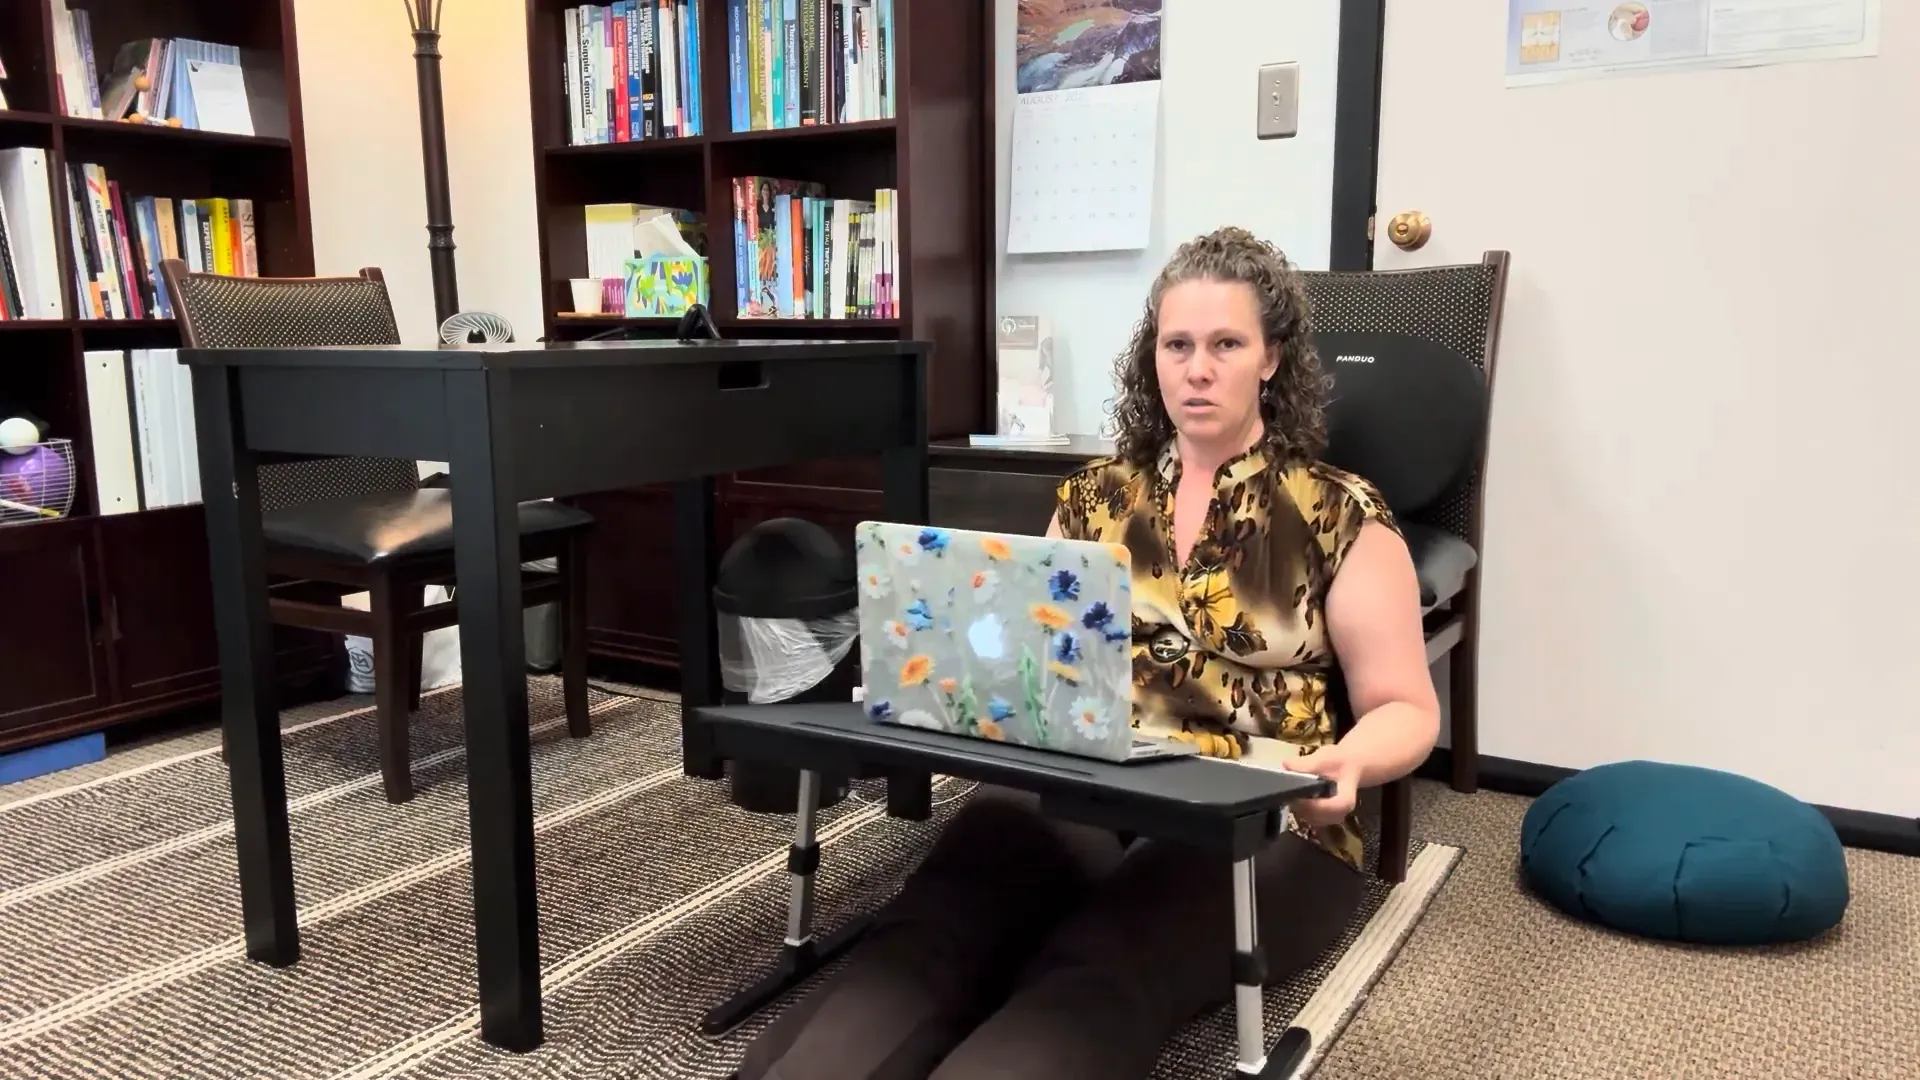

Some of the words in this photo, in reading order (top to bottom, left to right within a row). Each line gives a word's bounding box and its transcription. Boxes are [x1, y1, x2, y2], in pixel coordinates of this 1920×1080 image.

[581, 39, 590, 73] Supple
[788, 23, 796, 68] Therapeutic
[583, 75, 593, 115] Leopard
[95, 200, 106, 234] ANATOMY
[203, 222, 211, 250] EXPERT
[1336, 355, 1375, 363] PANDUO
